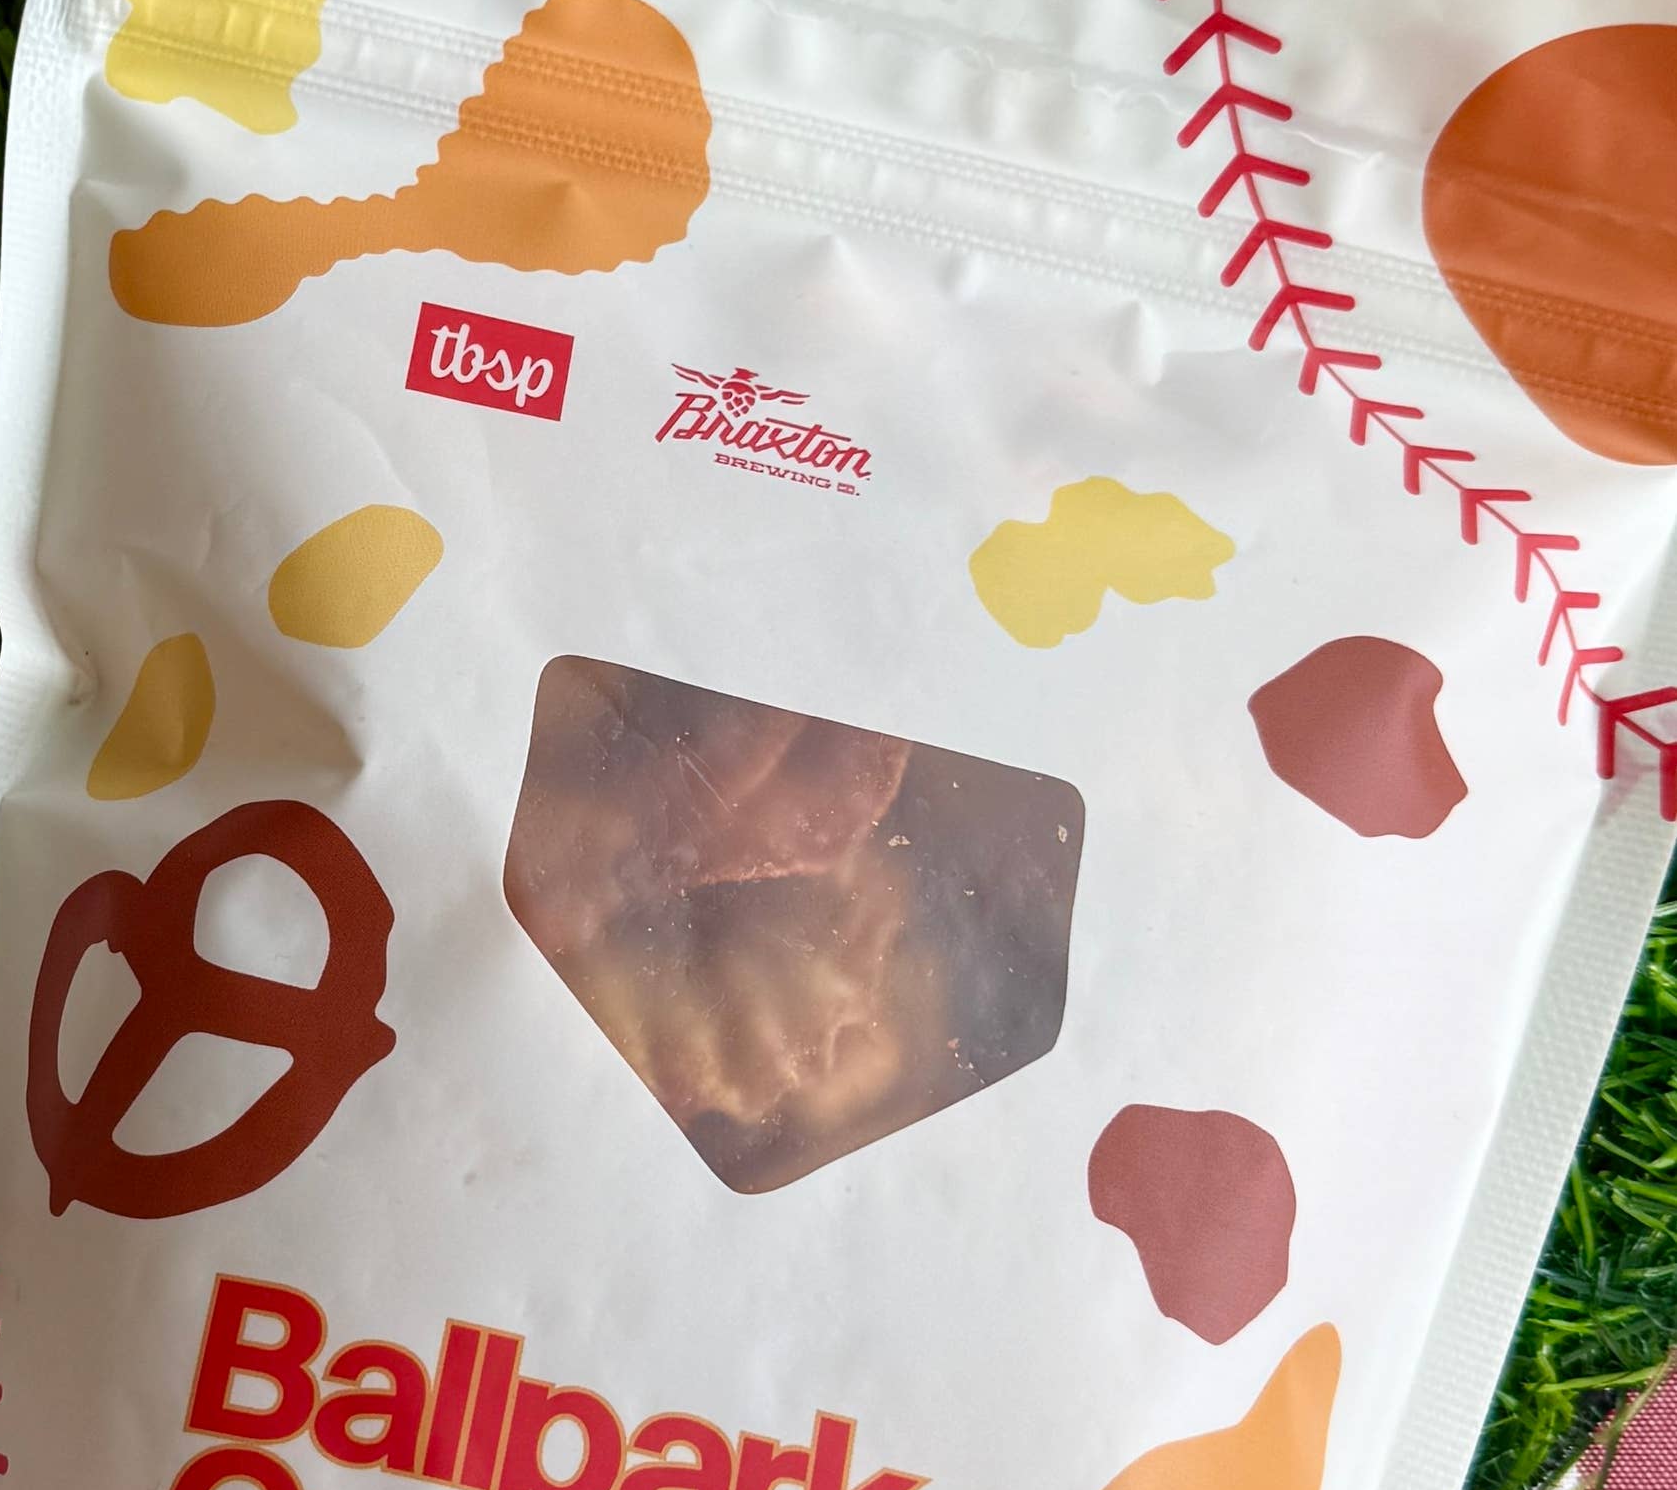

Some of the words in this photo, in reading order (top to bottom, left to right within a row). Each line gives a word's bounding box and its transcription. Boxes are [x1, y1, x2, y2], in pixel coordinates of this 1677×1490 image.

[430, 322, 554, 408] tbsp
[655, 393, 872, 478] Braxton
[714, 452, 831, 489] BREWING
